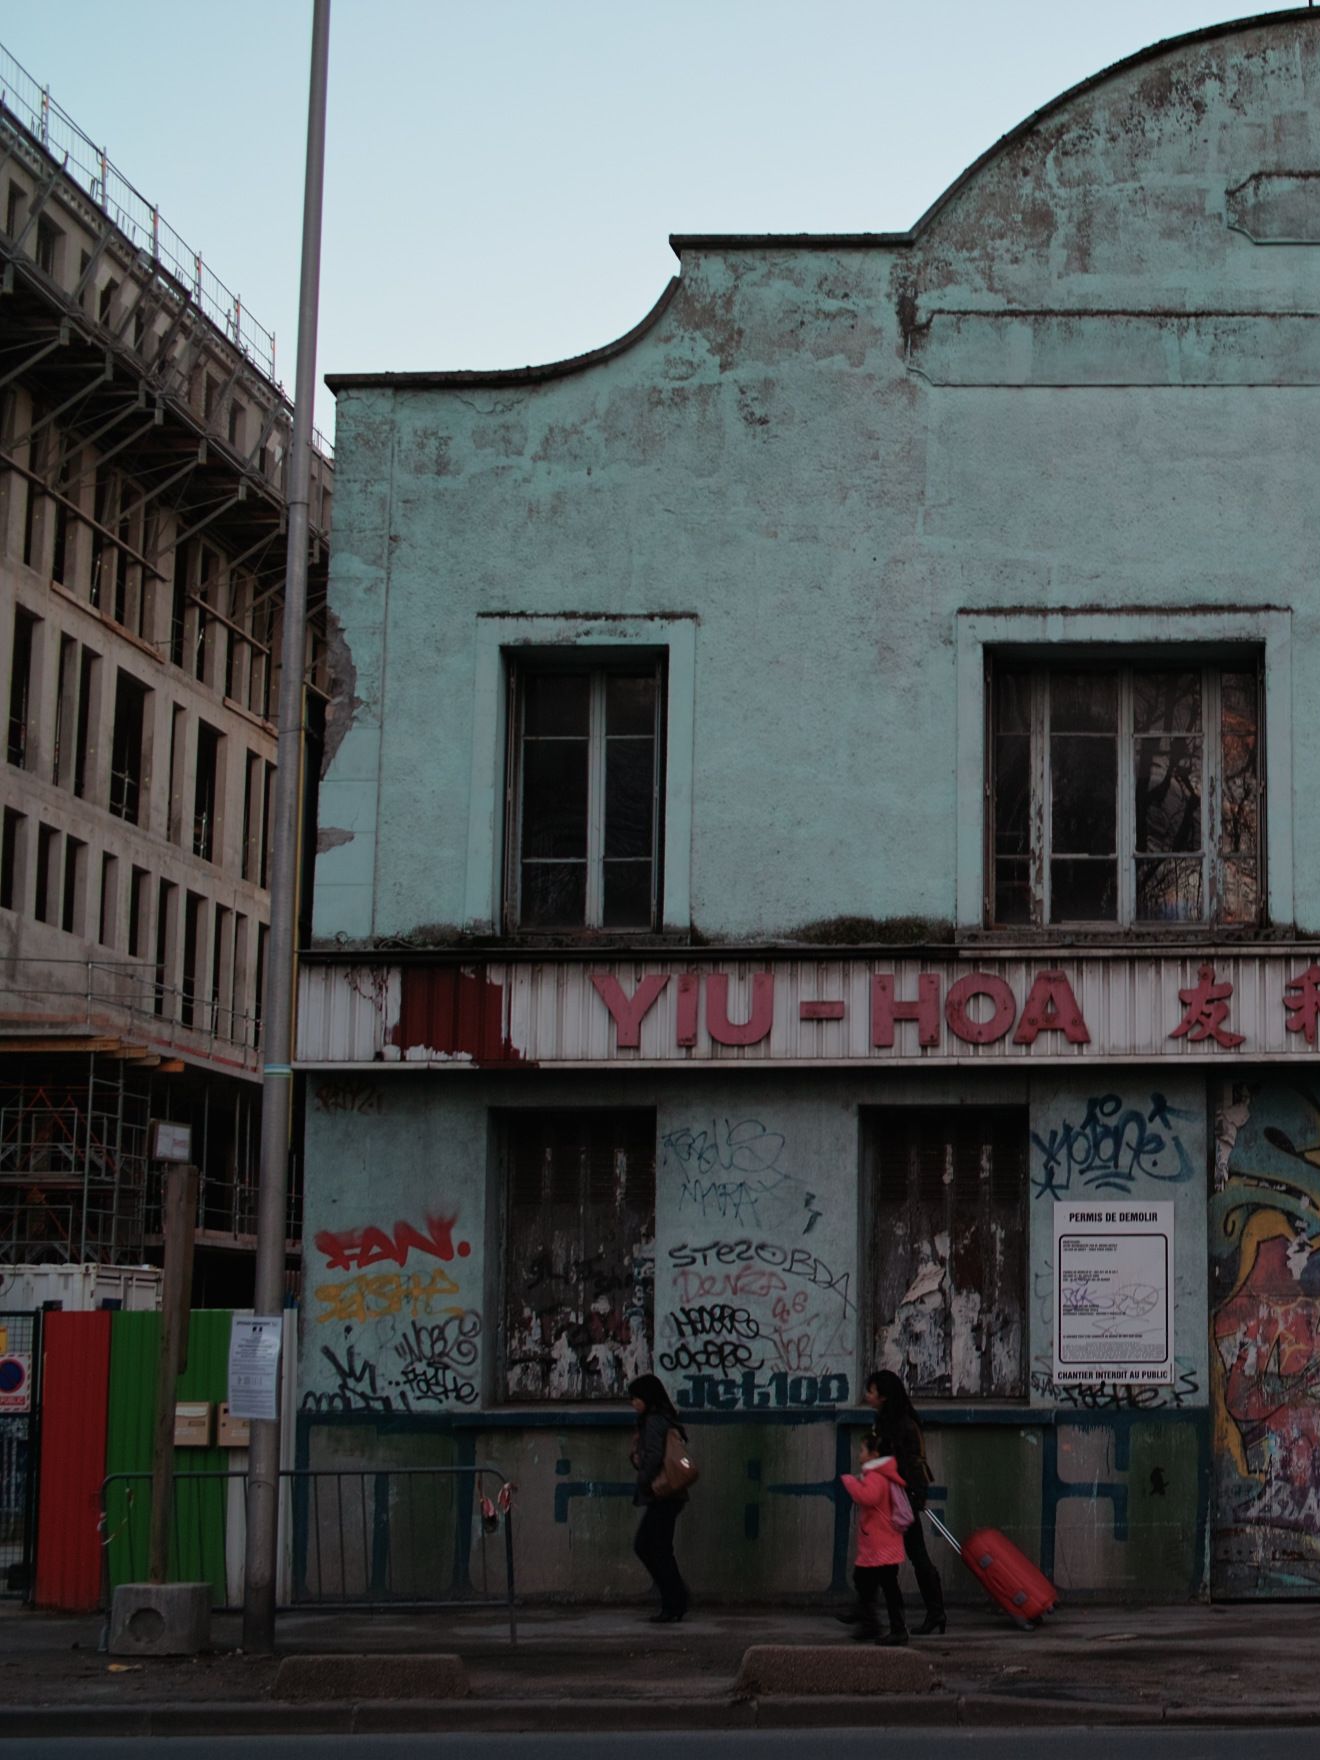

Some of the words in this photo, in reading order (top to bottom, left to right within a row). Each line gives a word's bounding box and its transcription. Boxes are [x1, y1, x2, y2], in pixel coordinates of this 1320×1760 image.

[1069, 1212, 1103, 1223] PERMIS
[1105, 1212, 1117, 1223] DE
[1119, 1211, 1158, 1223] DEMOLIR
[1057, 1371, 1093, 1380] CHANTIER
[1095, 1371, 1128, 1379] INTERDIT
[1130, 1371, 1140, 1379] AU
[1142, 1370, 1168, 1379] PUBLIC
